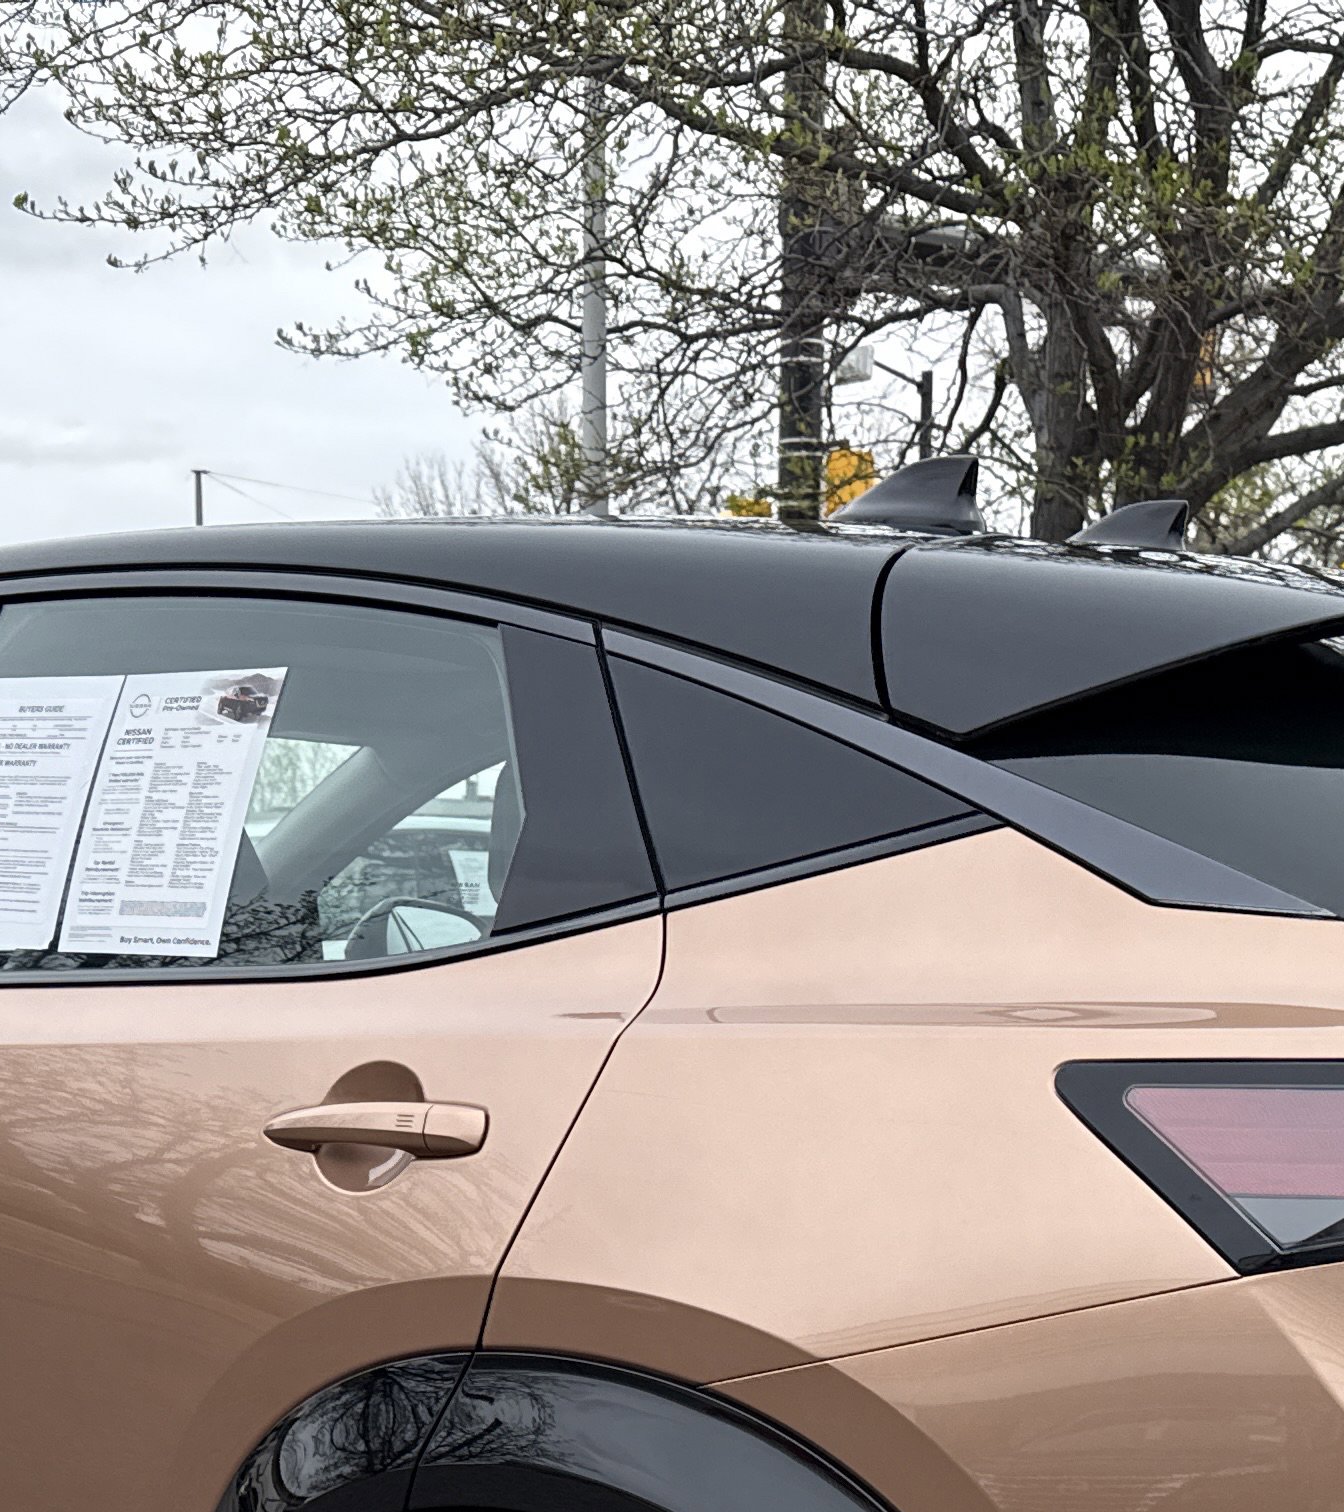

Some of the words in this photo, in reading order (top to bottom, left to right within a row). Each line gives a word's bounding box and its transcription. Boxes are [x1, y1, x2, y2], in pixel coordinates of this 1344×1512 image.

[124, 728, 152, 736] NISSAN
[117, 737, 154, 745] CERTIFIED
[120, 936, 132, 944] Buy
